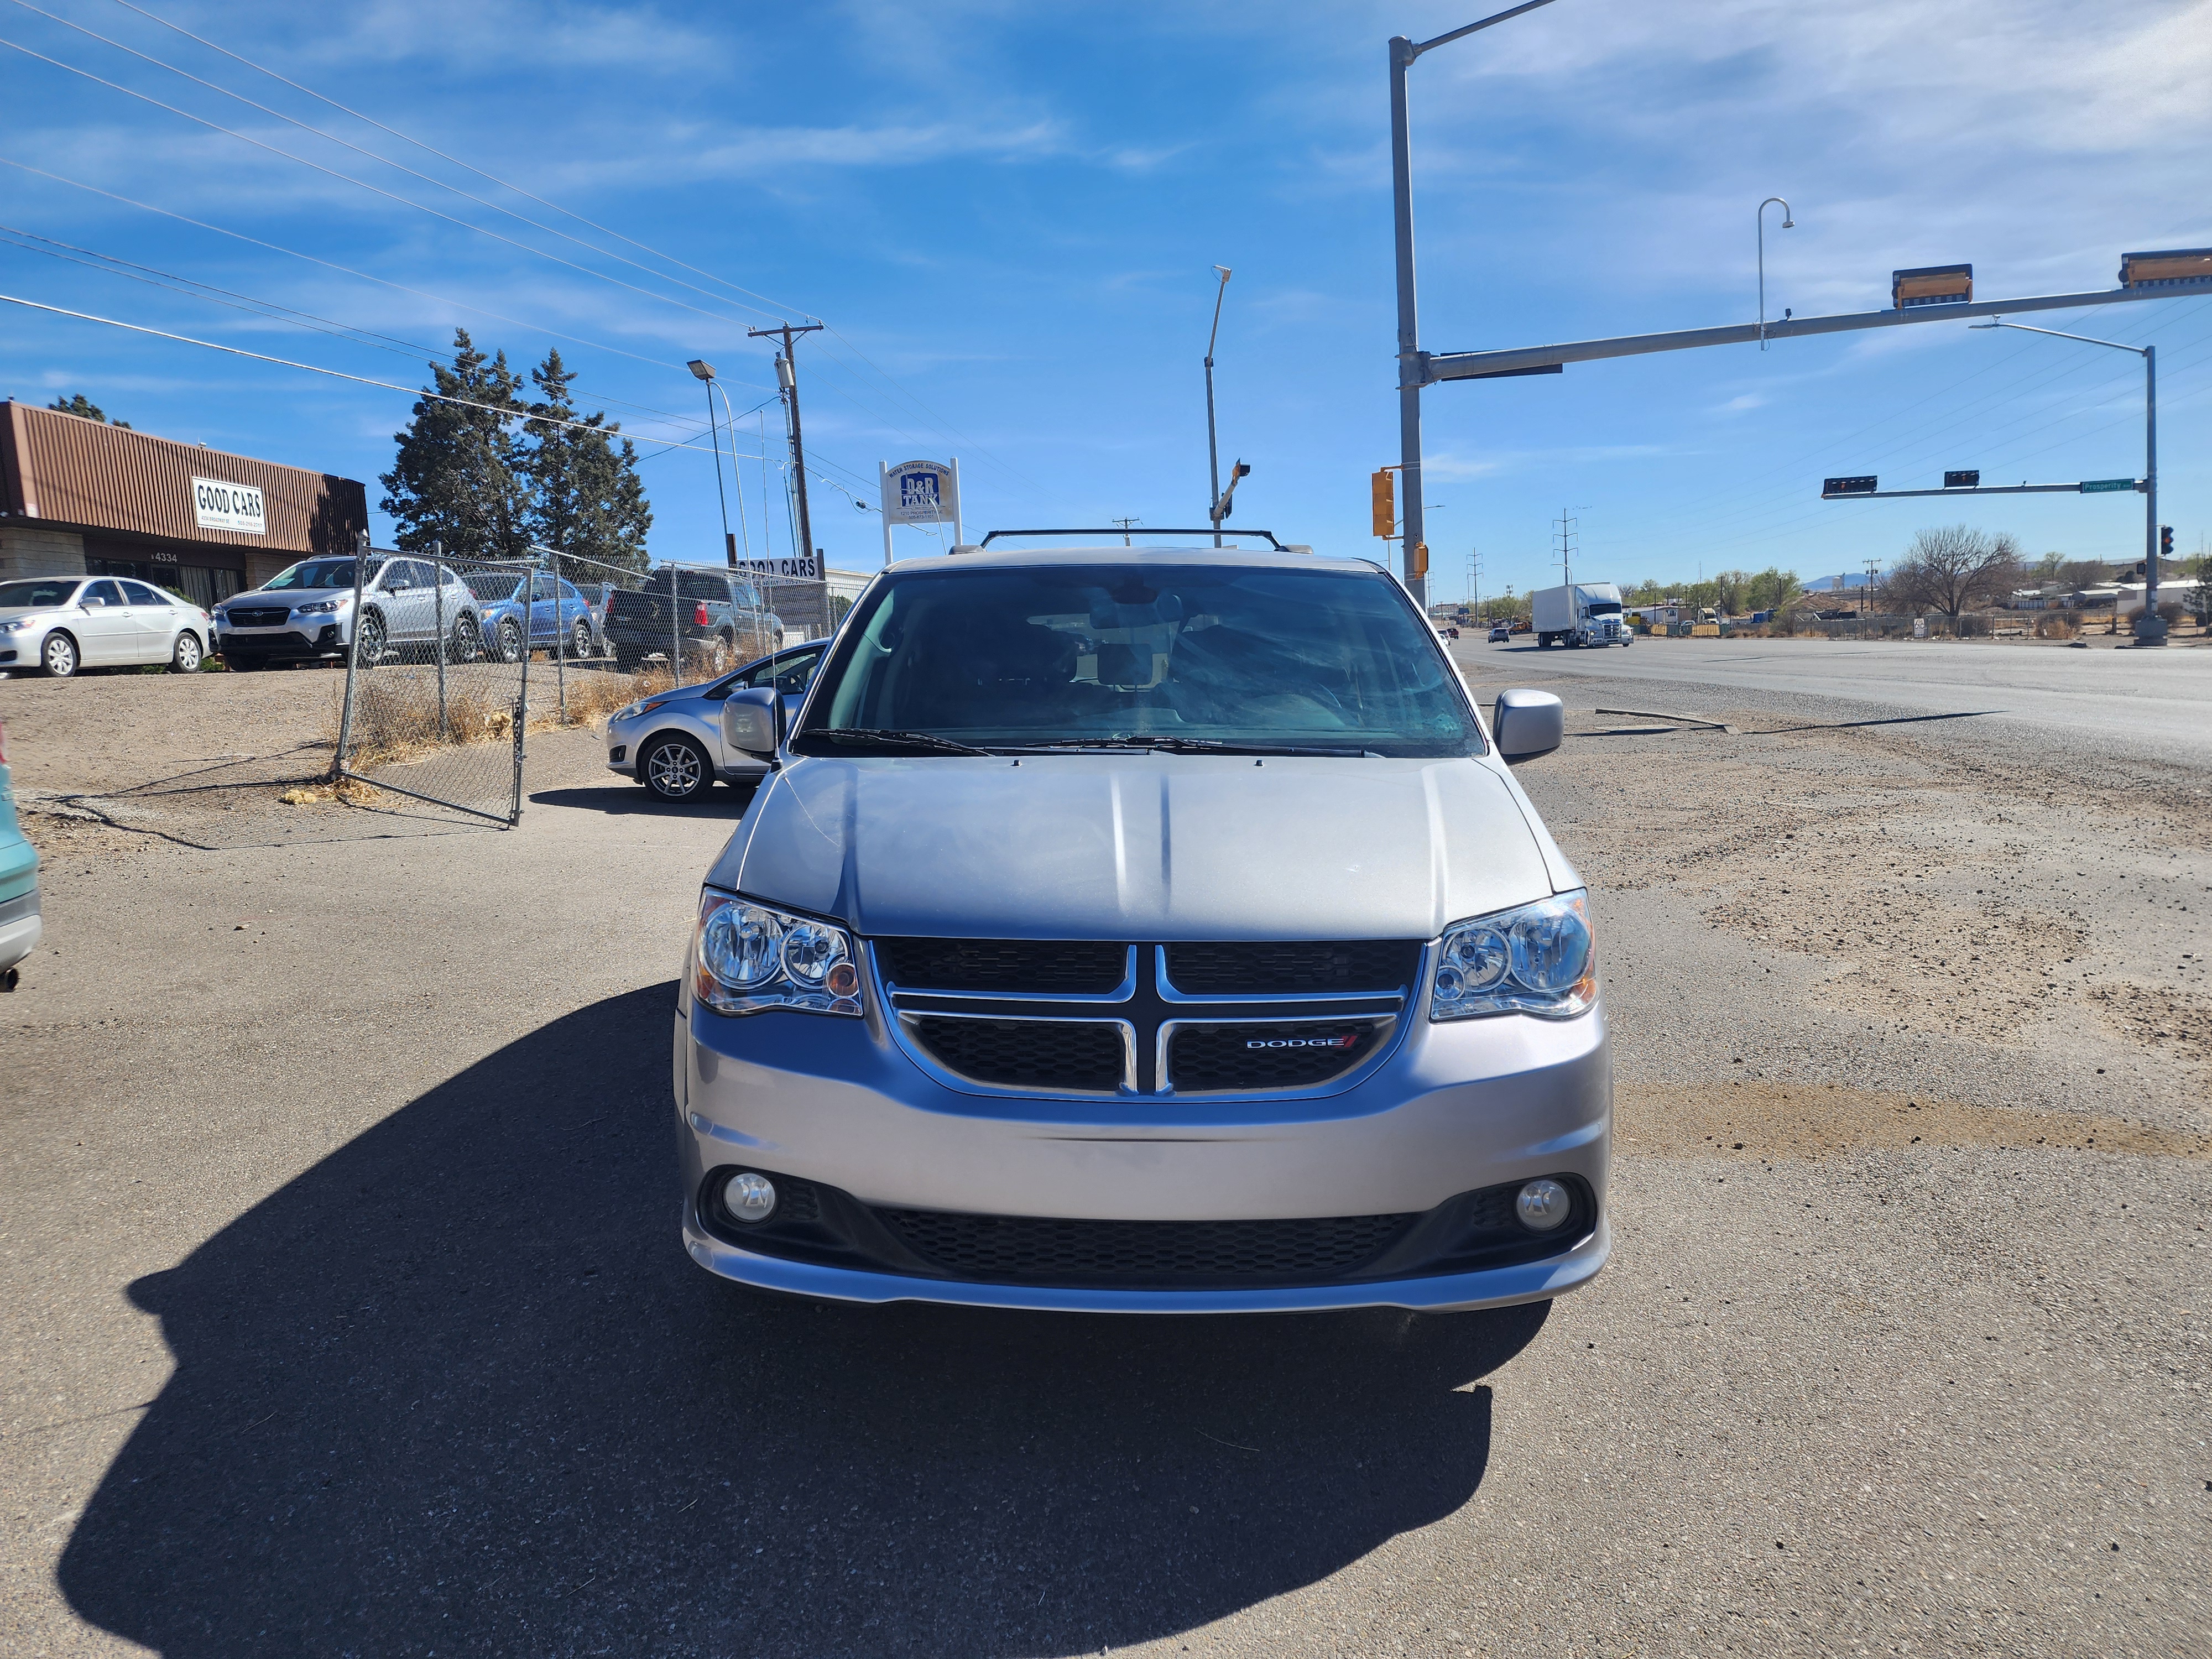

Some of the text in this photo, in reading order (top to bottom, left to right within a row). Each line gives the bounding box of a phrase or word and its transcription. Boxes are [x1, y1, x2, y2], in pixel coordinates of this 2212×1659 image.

[889, 468, 903, 478] WATER
[926, 464, 950, 476] SOLUTIONS
[907, 478, 933, 494] D&R
[198, 484, 260, 518] GOOD CARS
[903, 494, 939, 506] TANK
[155, 552, 178, 562] 4334
[781, 559, 815, 577] CARS
[1247, 1039, 1345, 1048] DODGE
